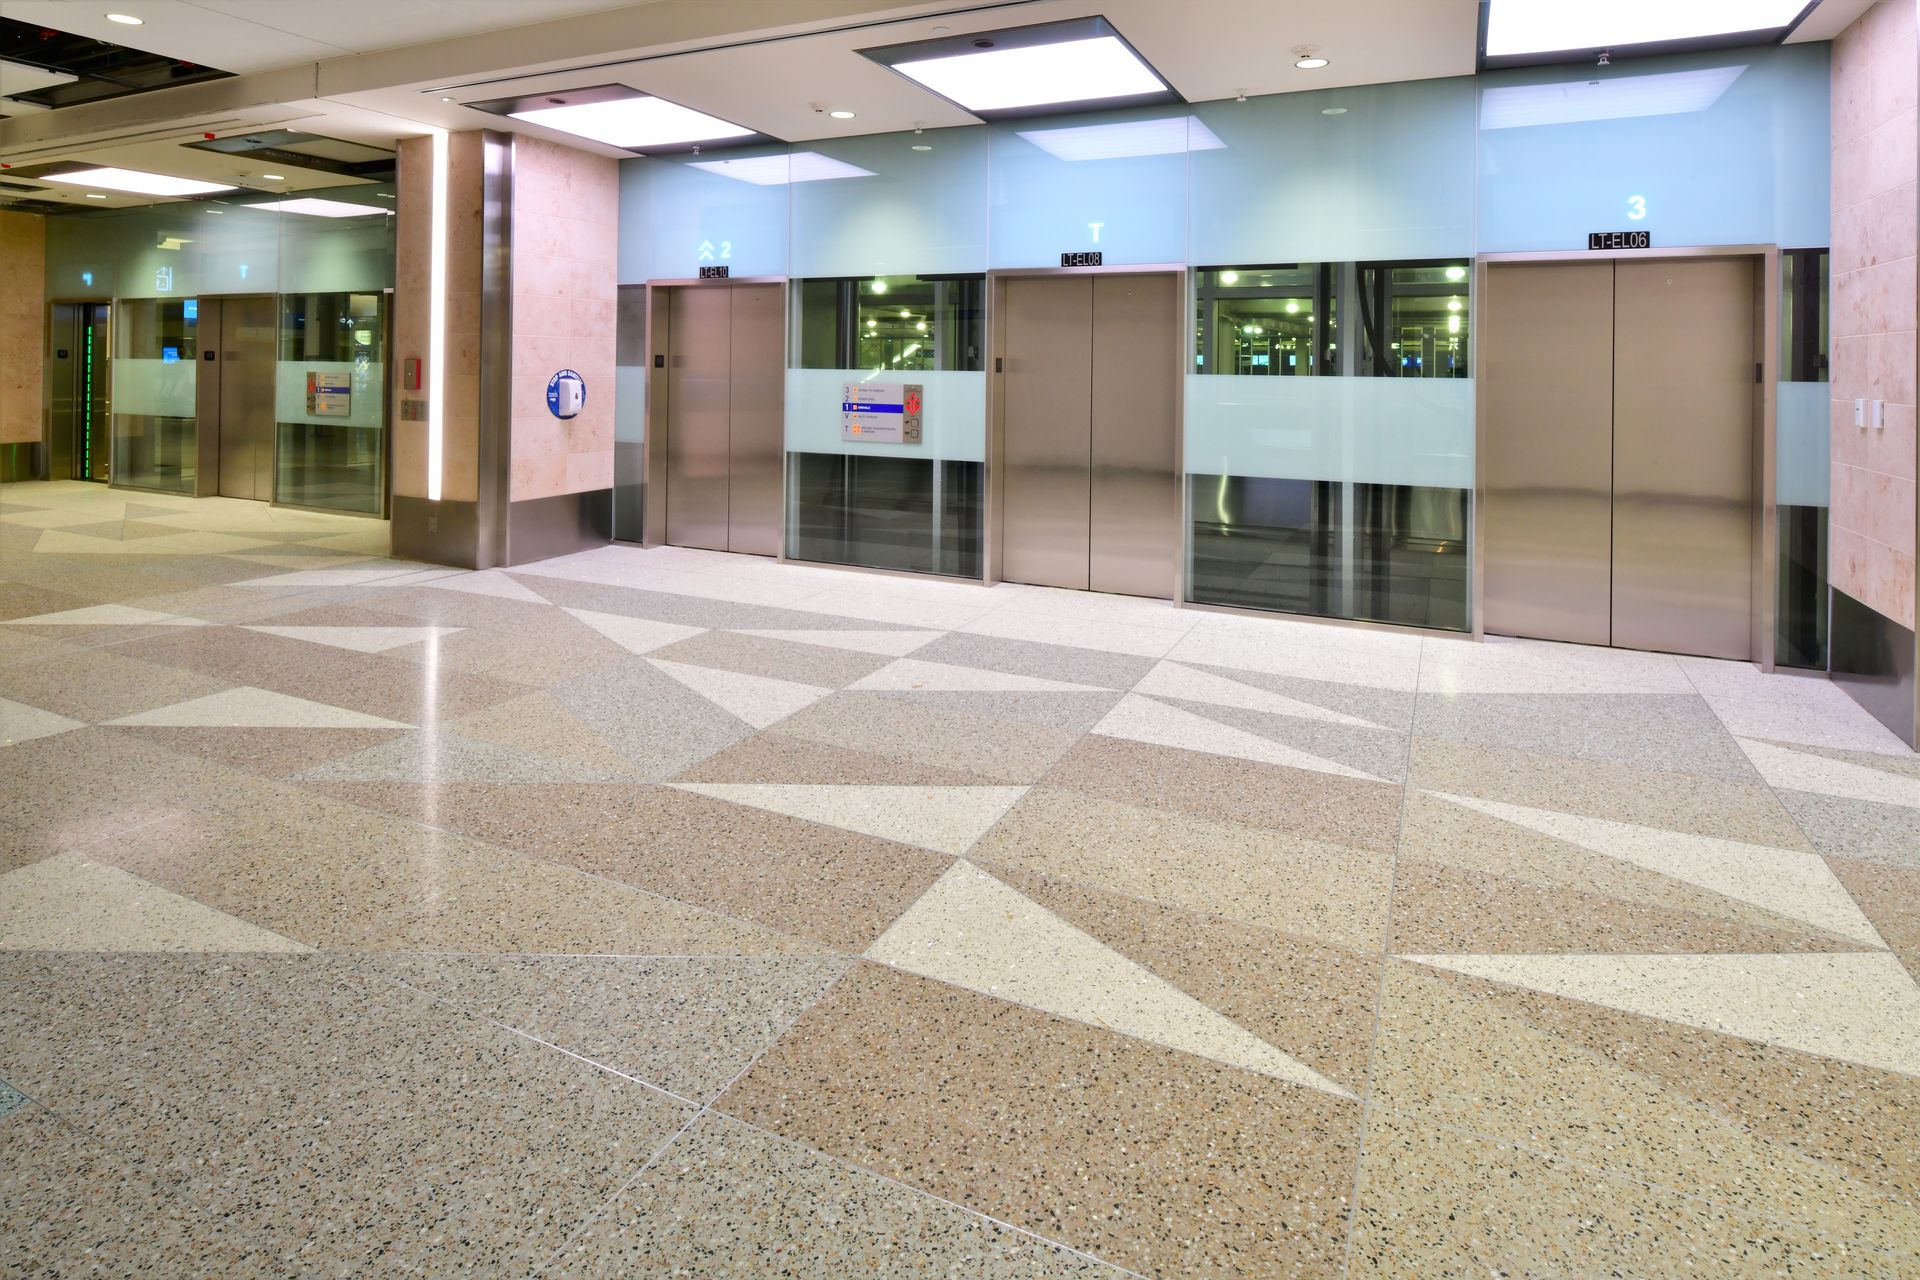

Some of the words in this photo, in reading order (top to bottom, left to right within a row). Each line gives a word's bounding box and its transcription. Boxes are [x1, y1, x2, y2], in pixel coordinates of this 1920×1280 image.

[1627, 195, 1646, 220] 3
[1088, 222, 1104, 243] T
[1591, 232, 1647, 249] LT-EL06
[721, 241, 732, 258] 2
[1062, 253, 1100, 266] LT-EL08
[700, 266, 728, 278] LT-EL10
